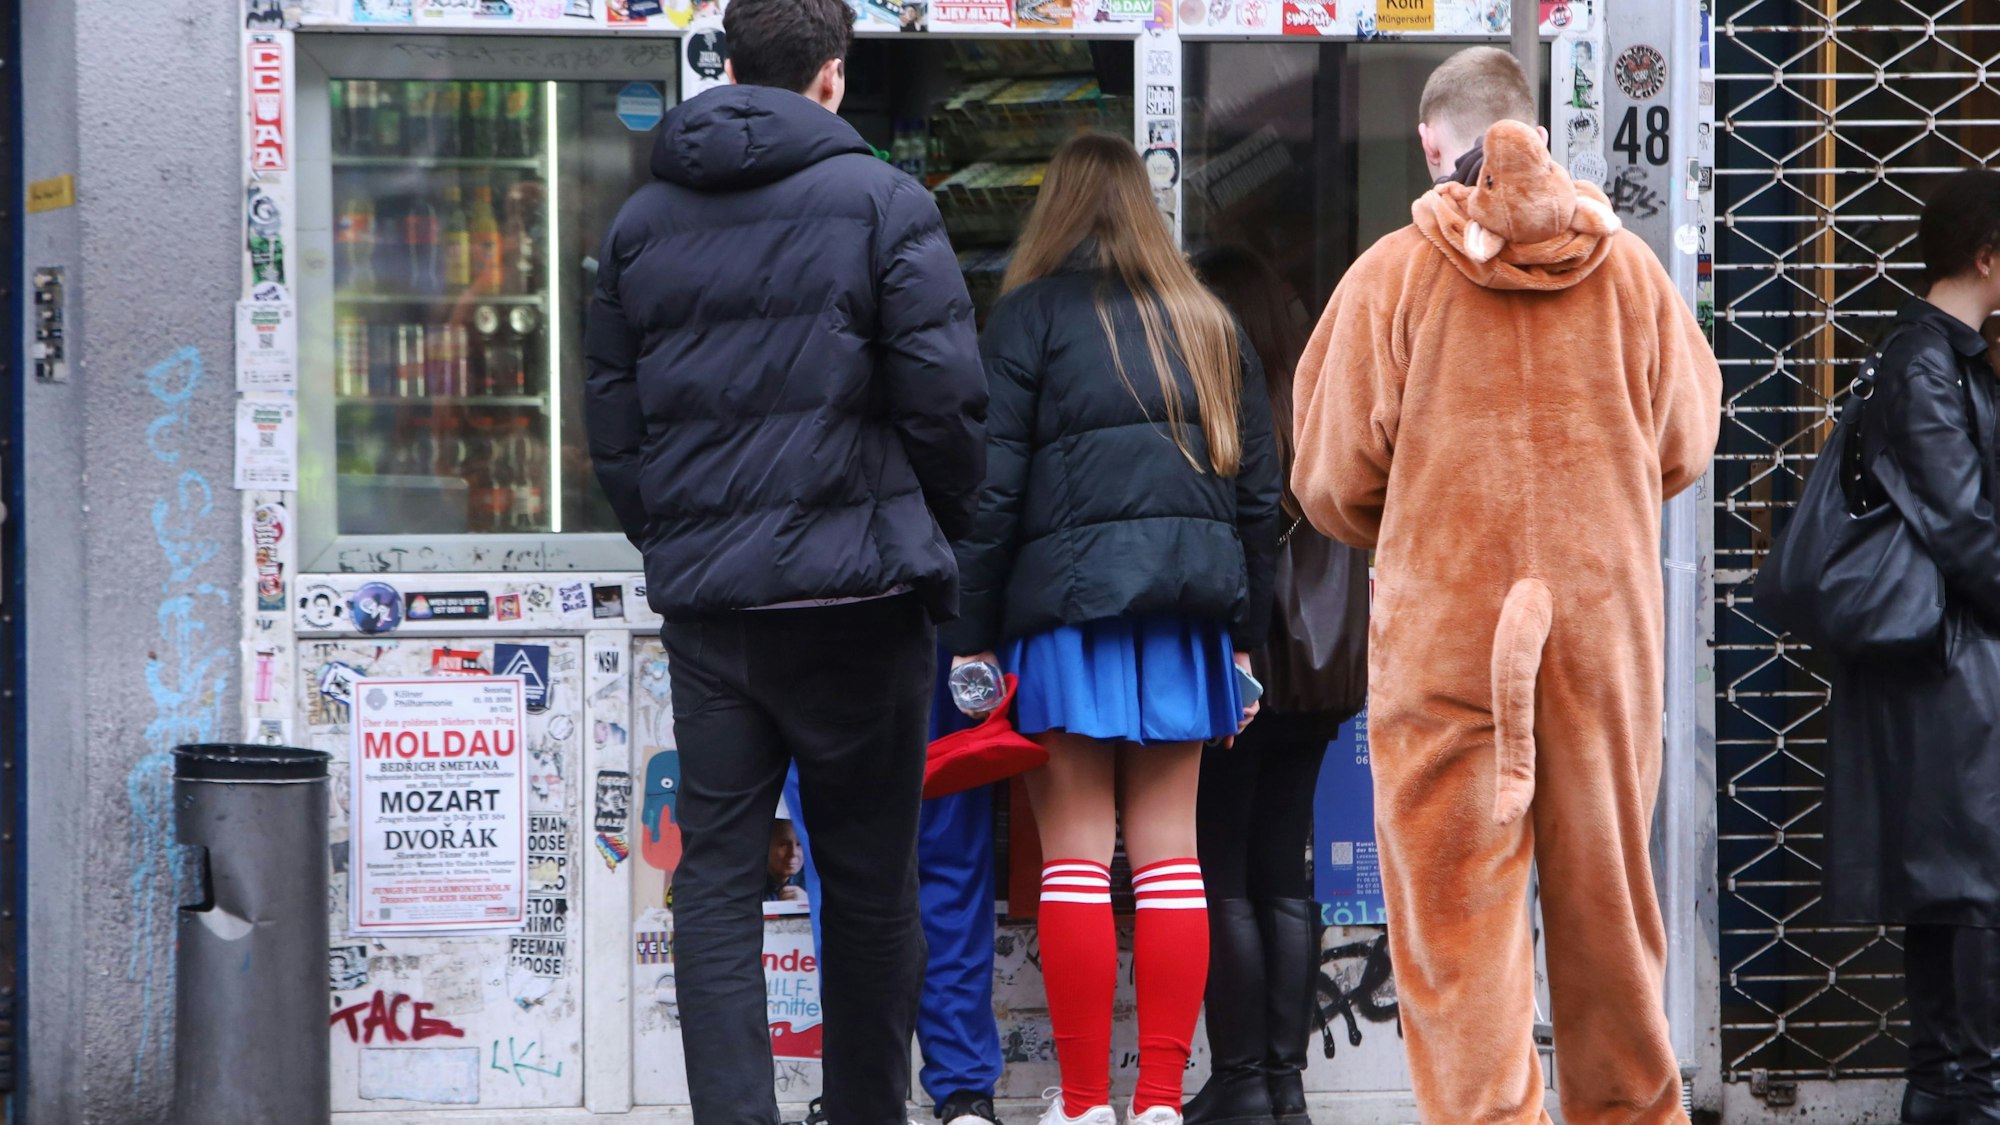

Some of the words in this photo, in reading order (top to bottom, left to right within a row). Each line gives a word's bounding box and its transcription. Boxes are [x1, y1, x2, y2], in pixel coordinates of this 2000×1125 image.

[1123, 2, 1150, 12] DAV
[1378, 15, 1431, 25] Müngersdorf
[1613, 106, 1669, 165] 48
[364, 729, 514, 759] MOLDAU
[380, 759, 435, 773] BEDŘICH
[439, 760, 499, 771] SMETANA
[380, 789, 500, 813] MOZART
[383, 822, 498, 851] DVOŘÁK
[405, 885, 483, 894] PHILHARMONIE
[485, 884, 511, 892] KÖLN
[638, 942, 674, 956] YEL
